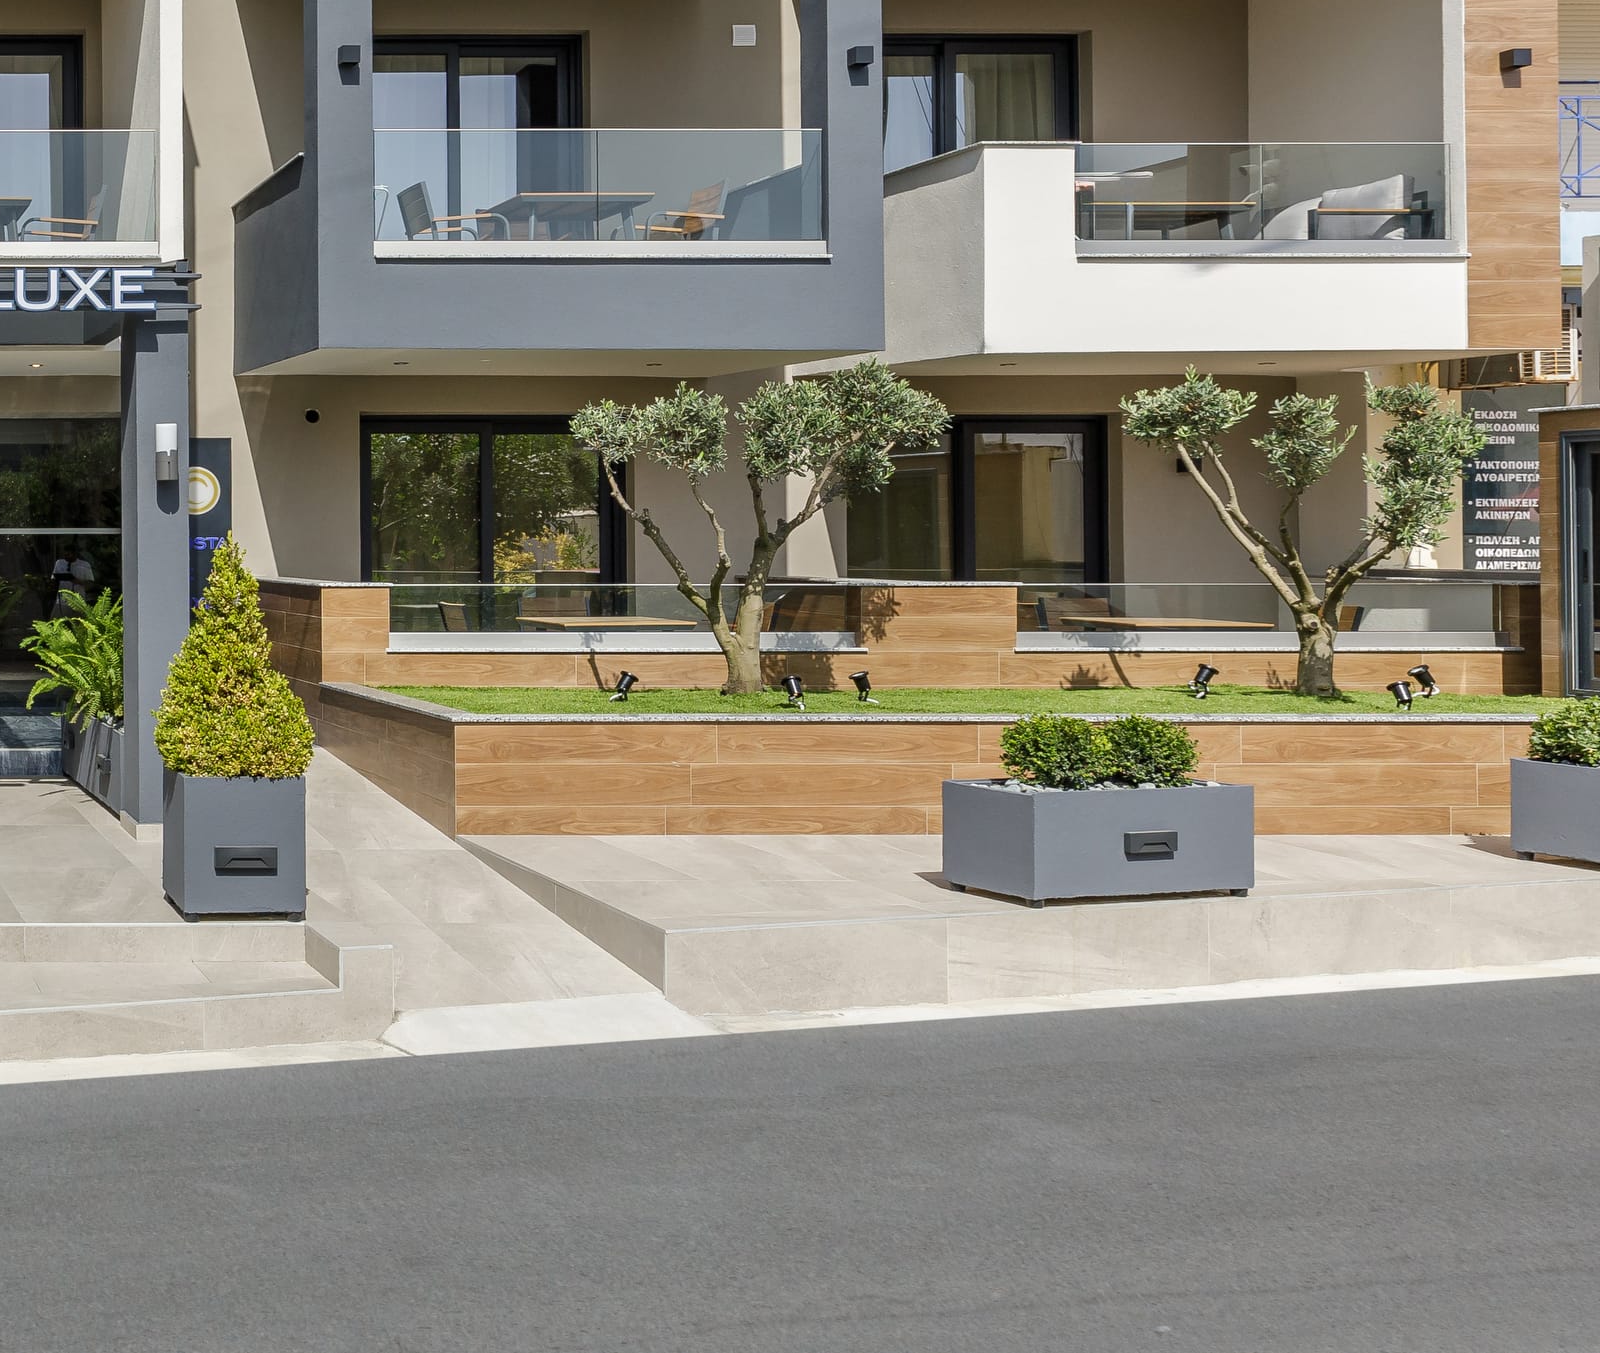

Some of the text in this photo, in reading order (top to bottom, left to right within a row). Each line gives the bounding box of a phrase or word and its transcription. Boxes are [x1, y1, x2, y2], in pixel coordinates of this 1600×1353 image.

[1474, 410, 1517, 420] ΕΚΔΟΣΗ
[1475, 498, 1539, 507] ΕΚΤΙΜΗΣΕΙΣ
[1475, 511, 1531, 520] ΑΚΙΝΗΤΩΝ
[1475, 548, 1540, 558] ΟΙΚΟΠΕΔΩΝ
